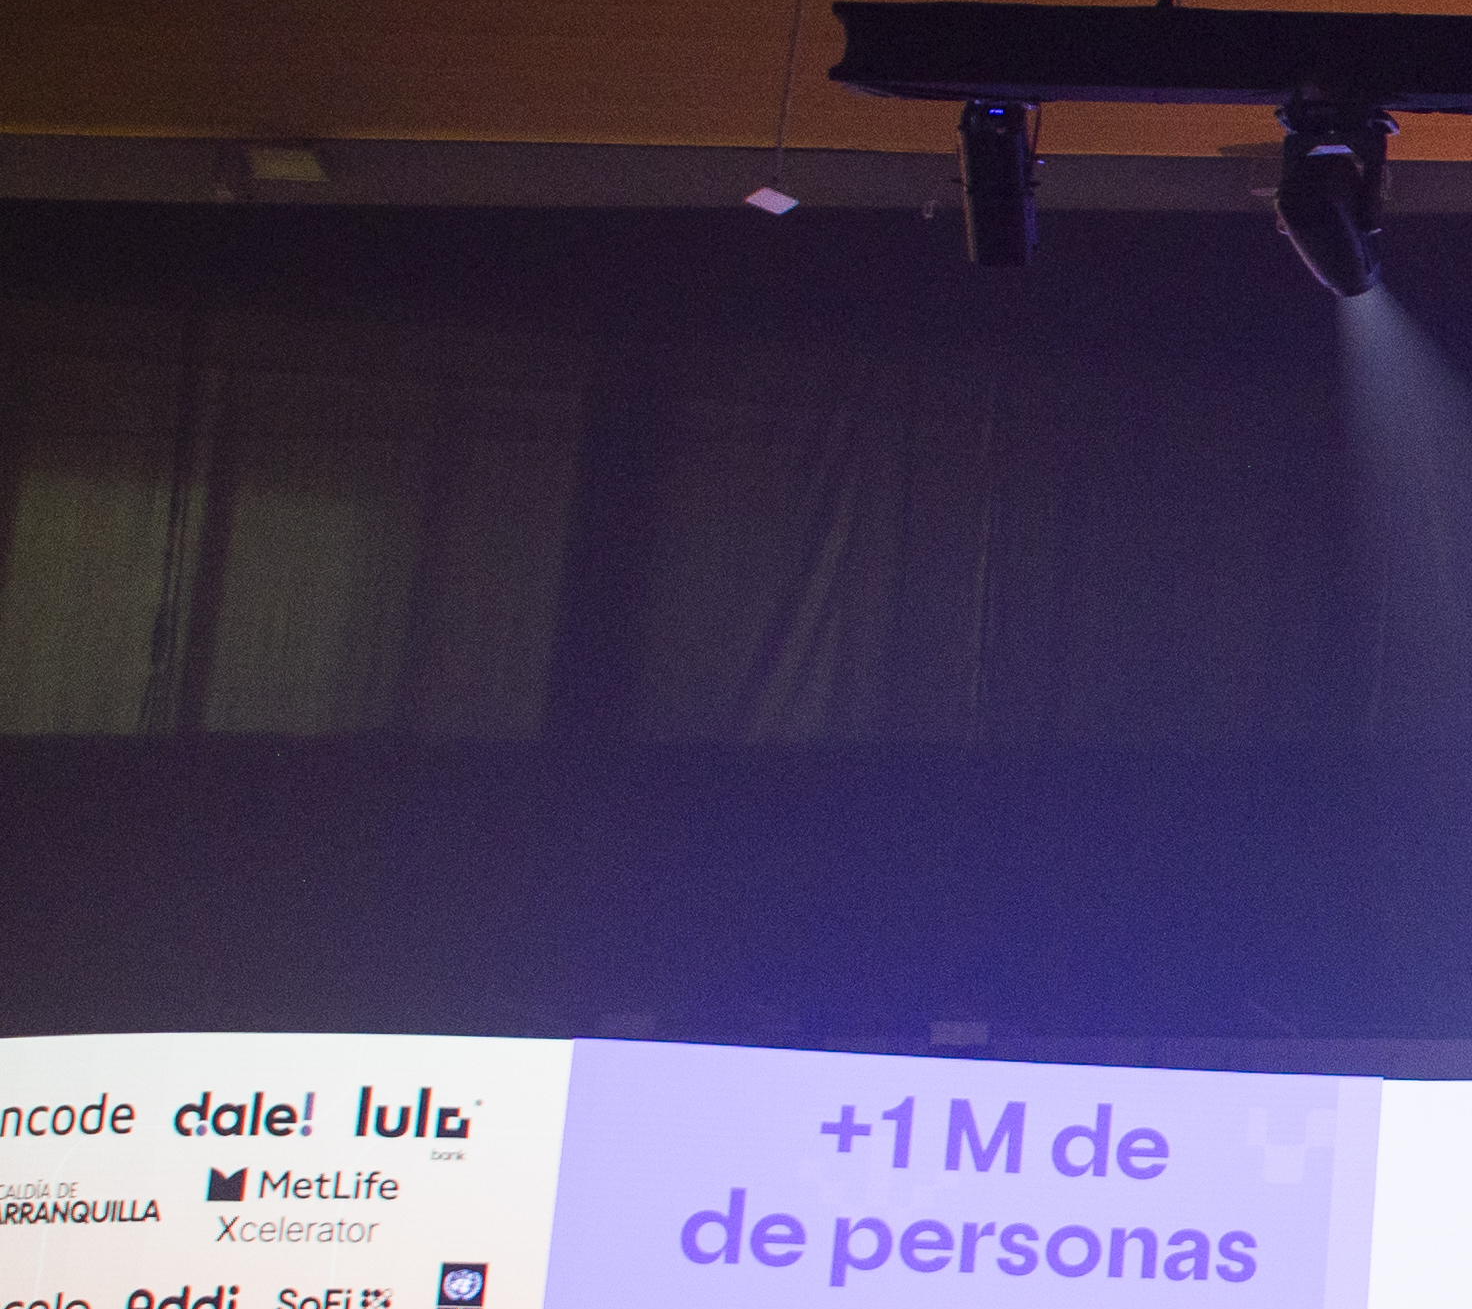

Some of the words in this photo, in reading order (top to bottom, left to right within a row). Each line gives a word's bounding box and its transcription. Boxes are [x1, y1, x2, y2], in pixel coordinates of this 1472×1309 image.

[174, 1091, 314, 1137] dale!
[820, 1096, 915, 1169] +1
[944, 1098, 1026, 1174] M
[1051, 1103, 1169, 1180] de
[259, 1170, 399, 1200] MetLife
[215, 1216, 379, 1243] Xcelerator
[680, 1187, 806, 1268] de
[829, 1217, 1257, 1288] personas
